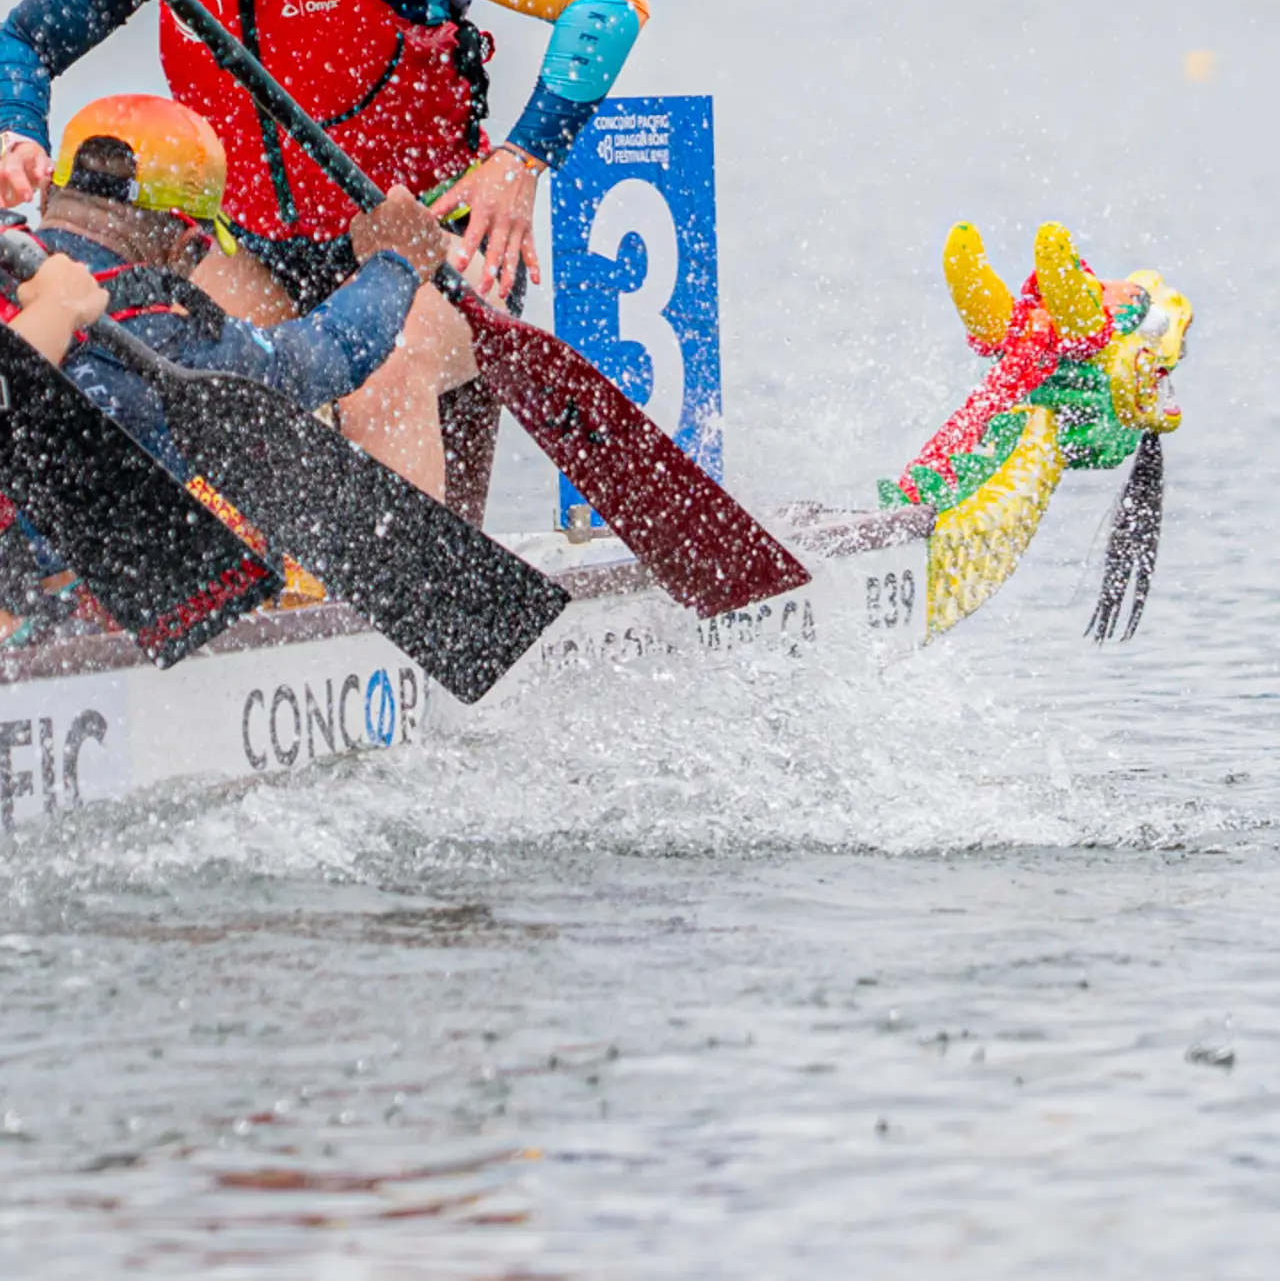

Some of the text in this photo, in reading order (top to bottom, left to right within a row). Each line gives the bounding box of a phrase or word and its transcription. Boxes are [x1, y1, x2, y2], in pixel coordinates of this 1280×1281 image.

[305, 0, 340, 13] Onyx
[587, 177, 685, 441] 3
[241, 666, 431, 771] CONCOR
